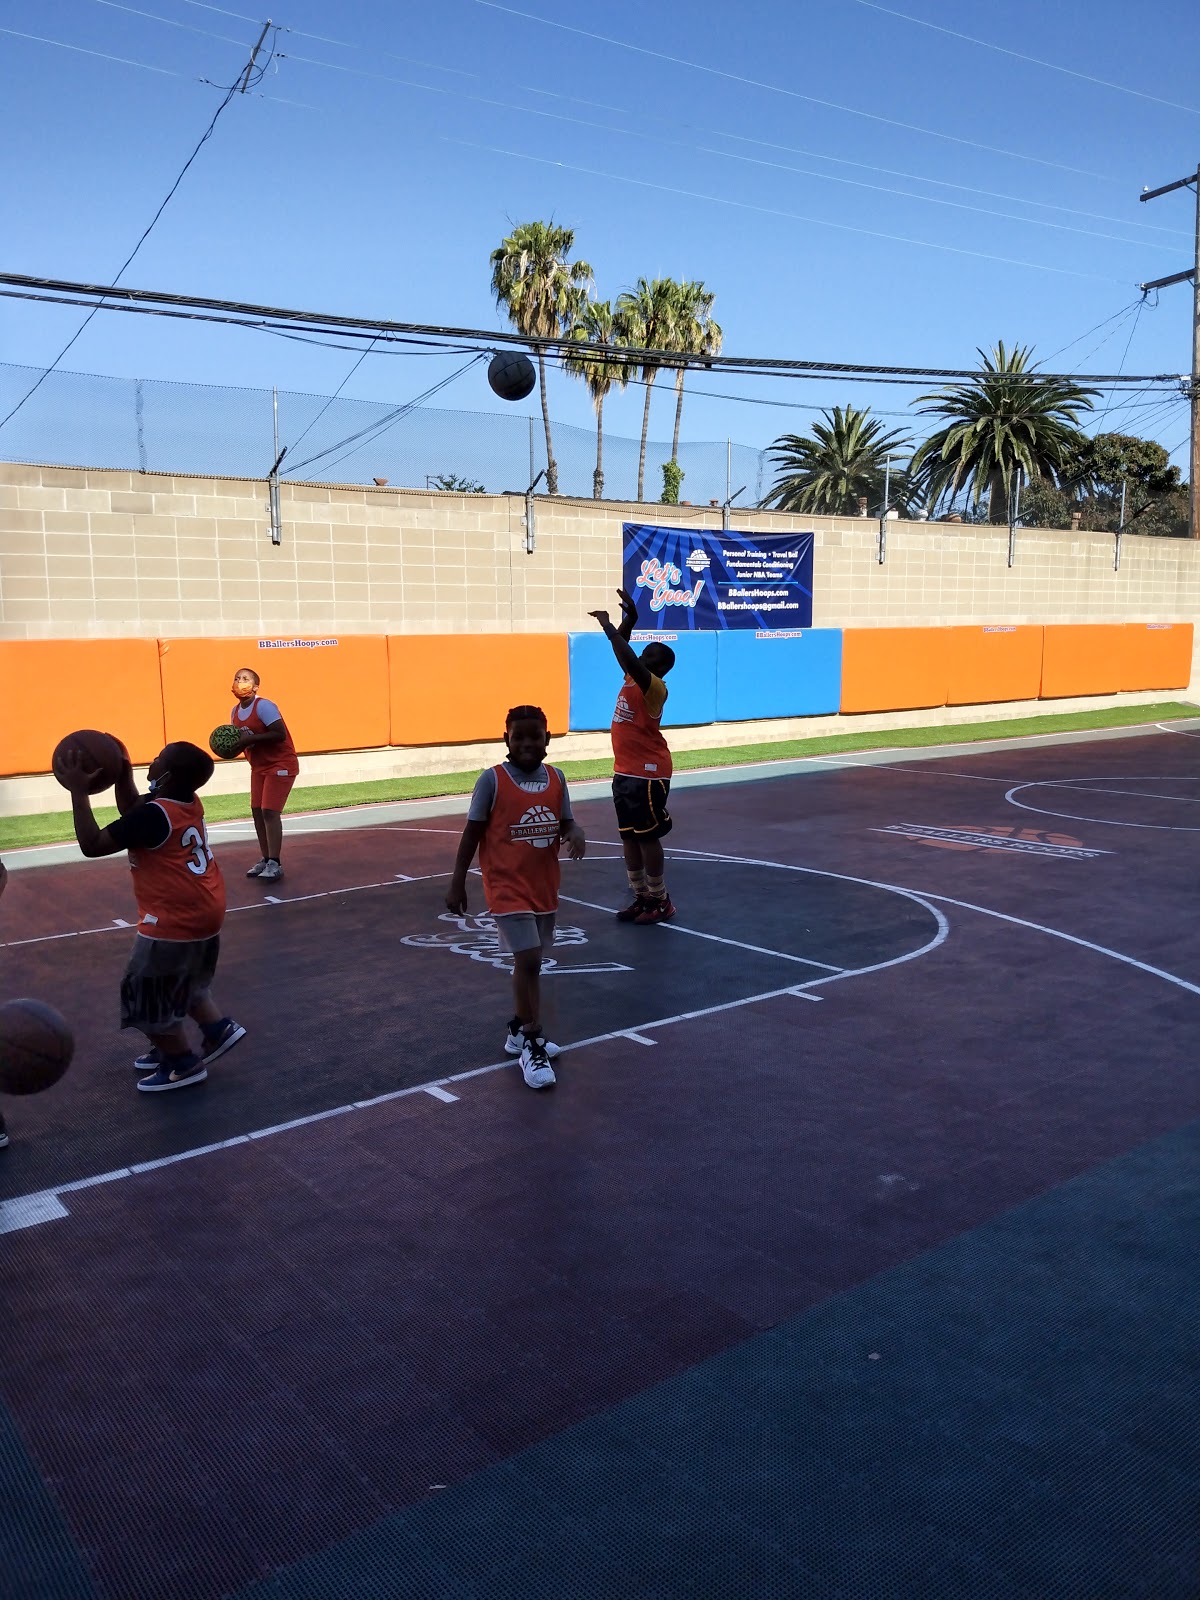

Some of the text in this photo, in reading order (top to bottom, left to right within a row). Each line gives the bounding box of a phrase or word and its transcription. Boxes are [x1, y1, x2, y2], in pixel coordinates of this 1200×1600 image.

[747, 551, 767, 559] Training
[726, 560, 794, 569] Fundamentals Conditioning
[636, 557, 682, 590] Let's
[650, 579, 706, 612] Gooo!
[728, 588, 789, 598] BBallersHoops.com
[717, 601, 799, 611] BBallershoops@gmail.com
[258, 639, 338, 648] BBallersHoops.com
